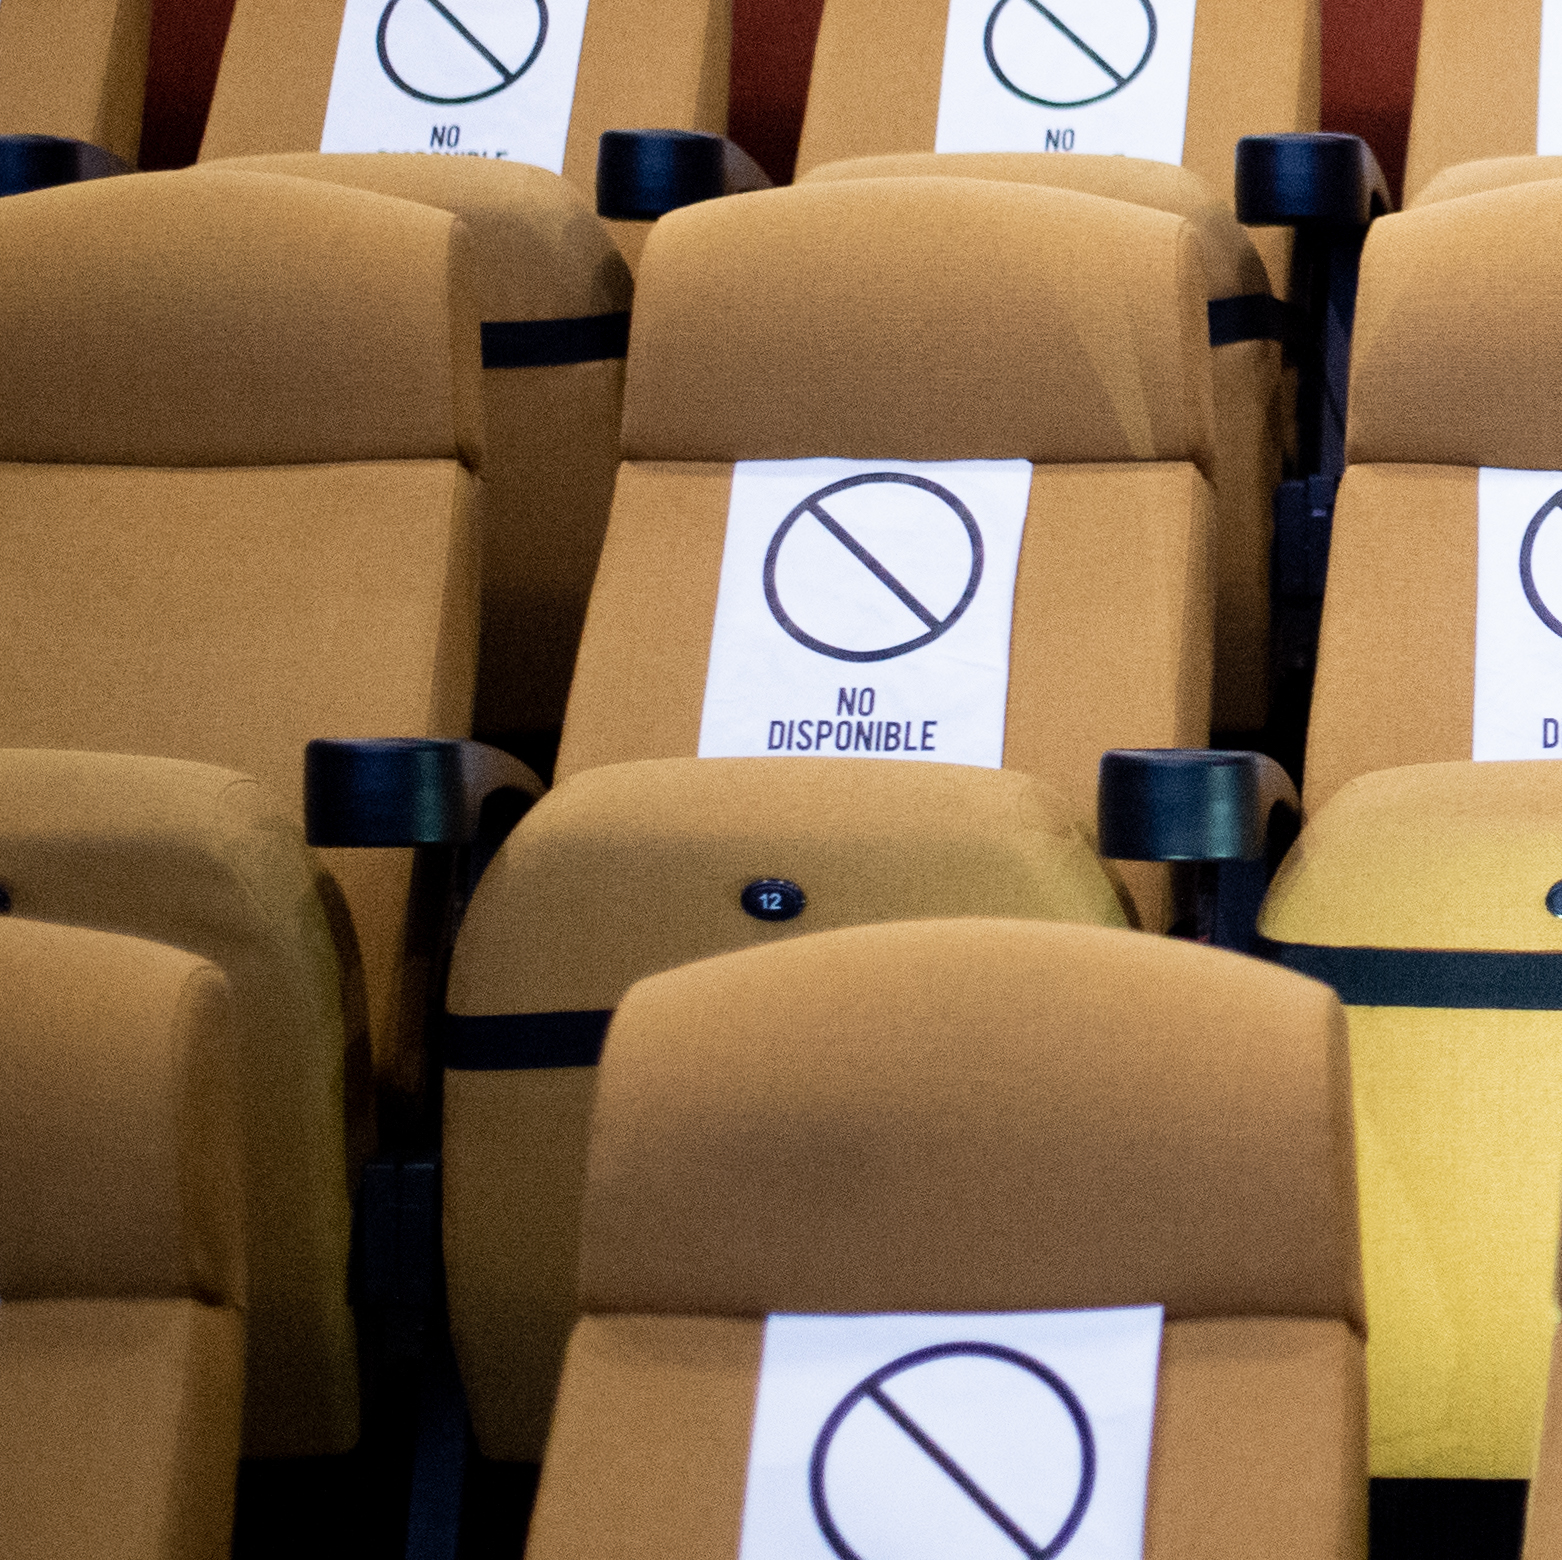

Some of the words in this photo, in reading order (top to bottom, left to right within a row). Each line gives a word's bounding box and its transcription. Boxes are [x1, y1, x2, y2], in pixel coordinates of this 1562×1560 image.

[430, 124, 461, 148] NO
[1044, 128, 1075, 151] NO
[837, 686, 876, 717] NO
[767, 720, 938, 751] DISPONIBLE
[759, 893, 782, 910] 12
